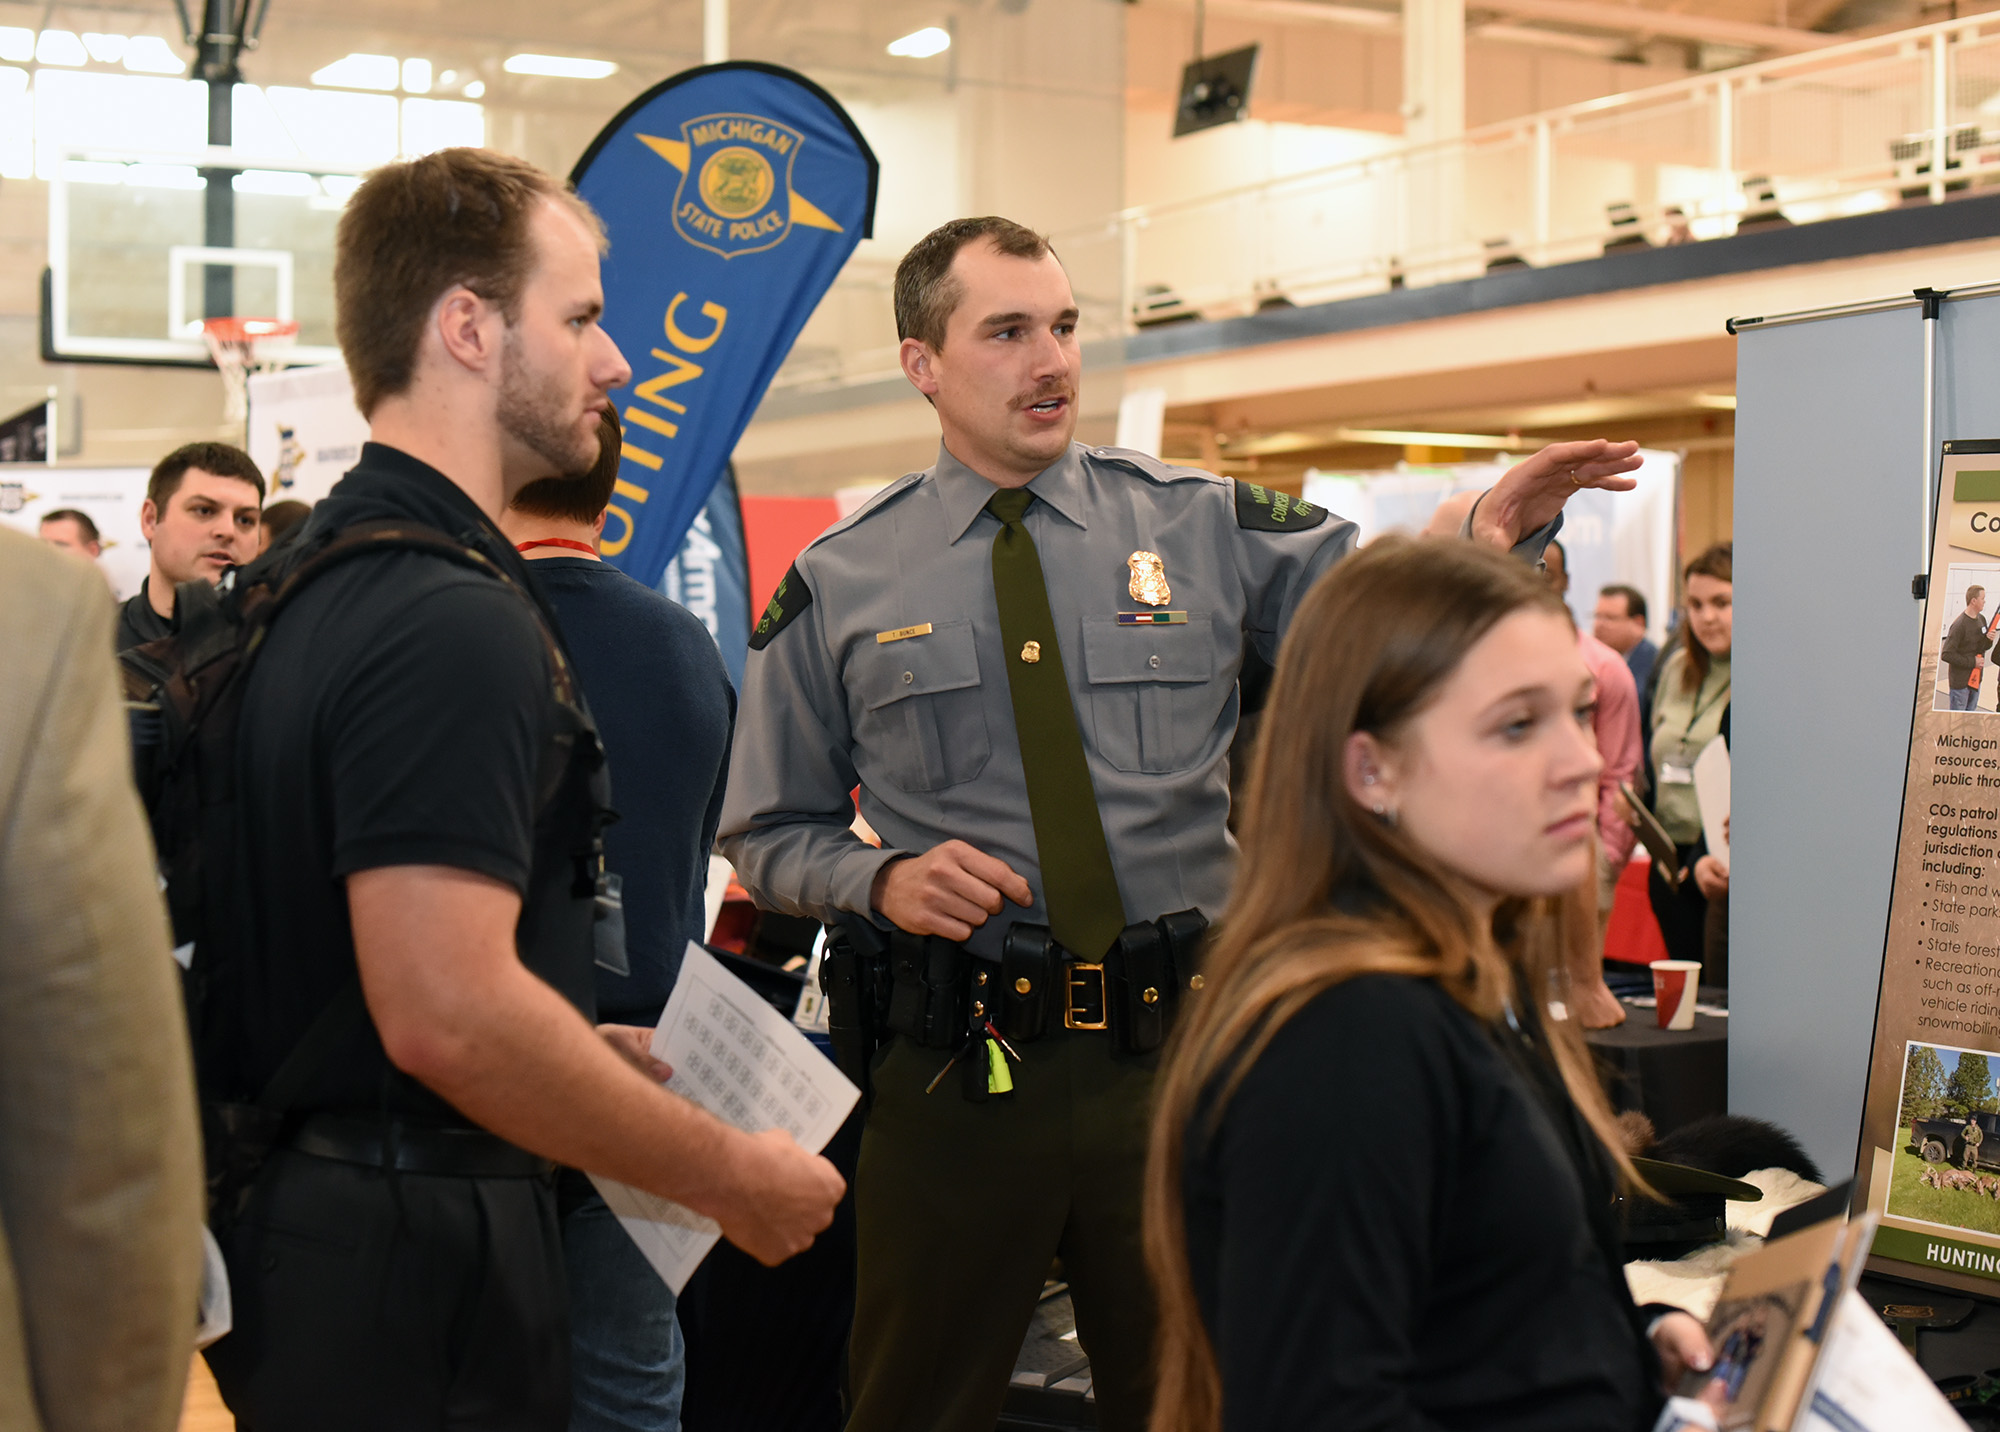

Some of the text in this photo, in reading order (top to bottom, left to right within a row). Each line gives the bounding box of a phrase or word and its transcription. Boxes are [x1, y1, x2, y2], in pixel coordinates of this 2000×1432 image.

[692, 120, 793, 155] MICHIGAN
[679, 202, 784, 241] STATE POLICE
[1971, 511, 2000, 533] Co
[1937, 735, 1998, 751] Michigan
[1935, 755, 2000, 770] resources,
[1932, 773, 1973, 786] public
[1929, 804, 1998, 821] COs patrol
[1926, 824, 1998, 839] regulations
[1923, 840, 1993, 858] jurisdiction
[1922, 859, 1986, 879] including:
[1934, 879, 1957, 894] Fish
[1961, 884, 1988, 897] and
[1932, 899, 2000, 918] State park
[1931, 918, 1959, 934] Trails
[1927, 937, 1961, 953] State
[1922, 978, 1953, 991] such
[1956, 982, 1971, 994] as
[1920, 997, 2000, 1020] vehicle ridin
[1918, 1015, 2000, 1039] snowmobilin
